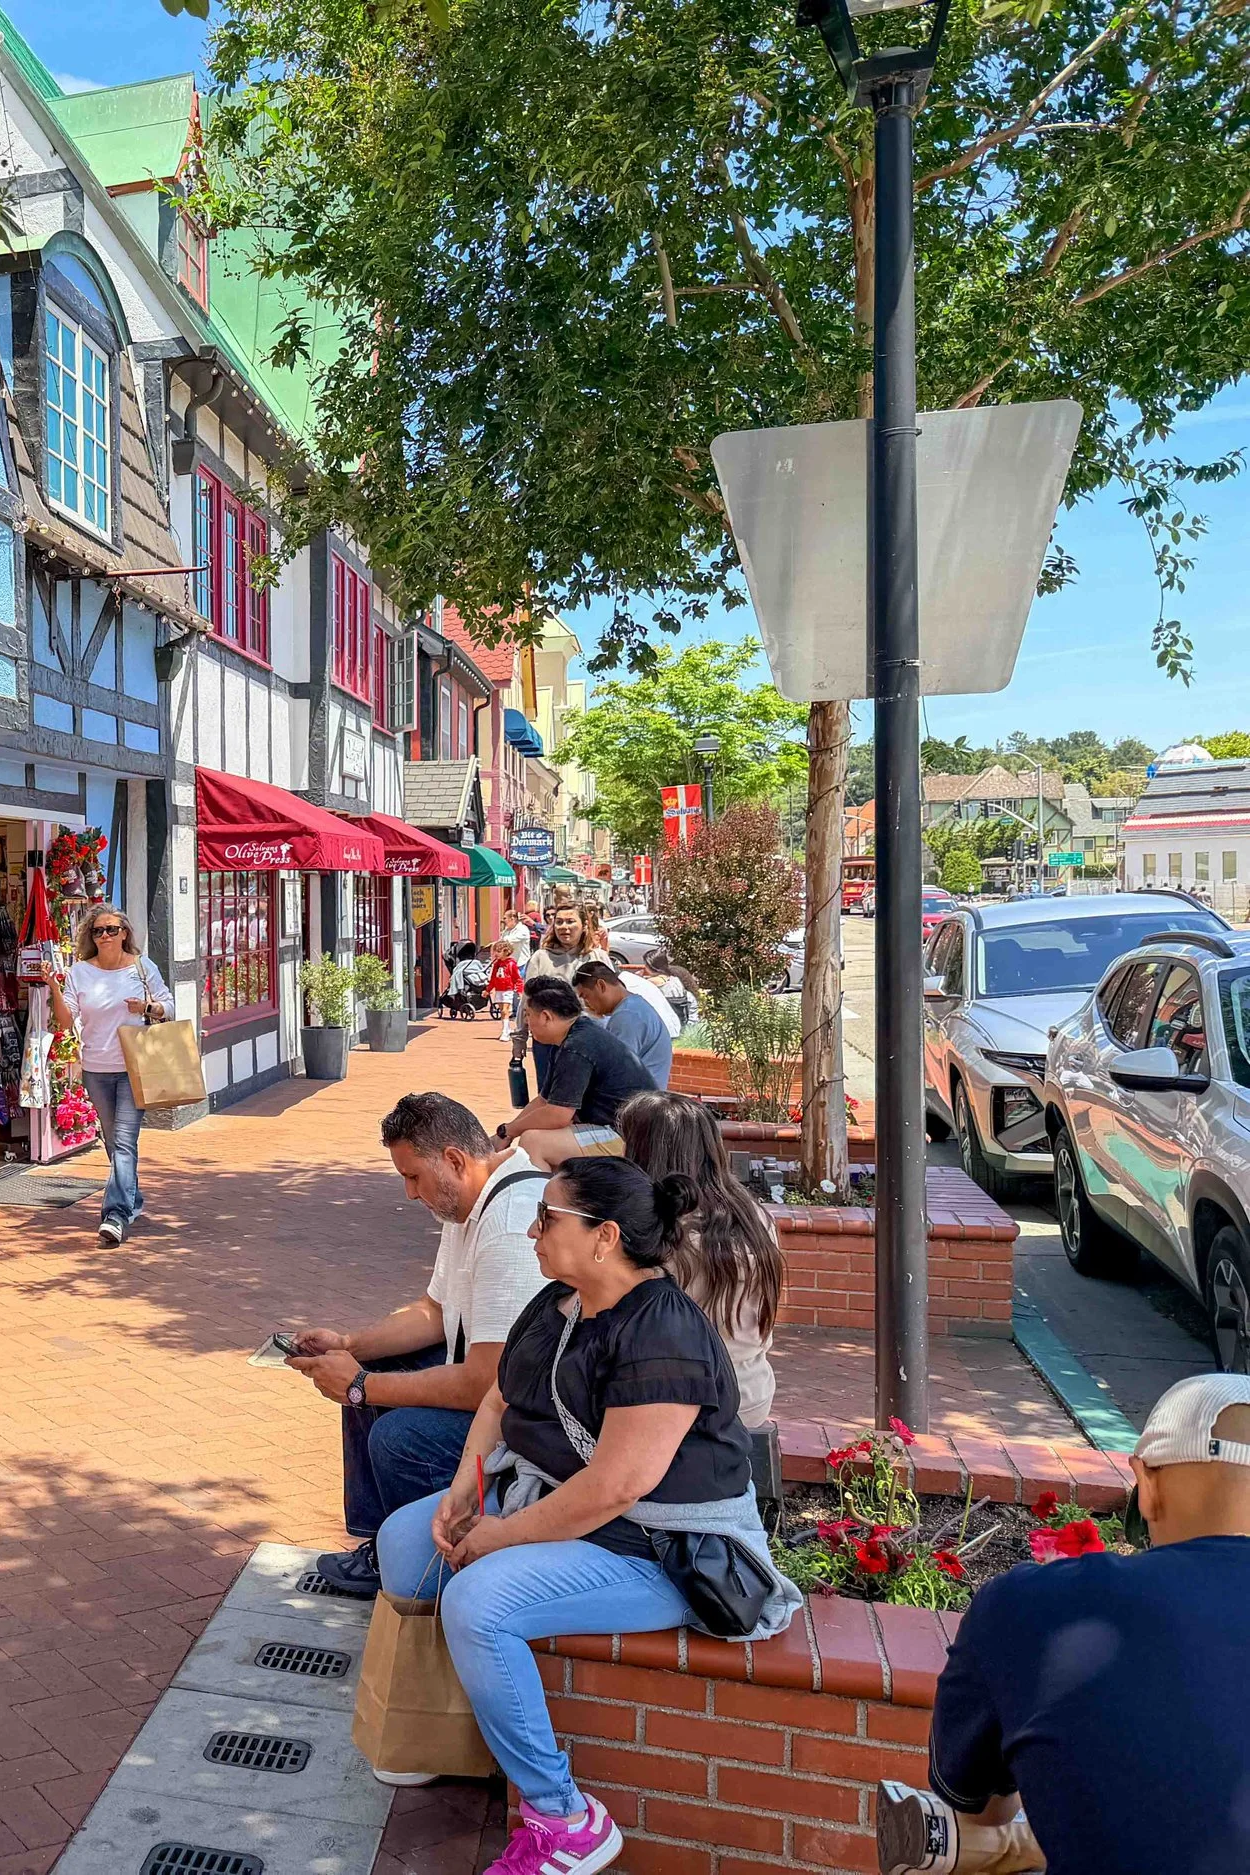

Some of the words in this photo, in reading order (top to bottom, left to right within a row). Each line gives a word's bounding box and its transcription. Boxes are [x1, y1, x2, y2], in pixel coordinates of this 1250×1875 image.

[510, 835, 553, 847] Denmark
[224, 842, 259, 860] Olive
[253, 850, 291, 865] Press
